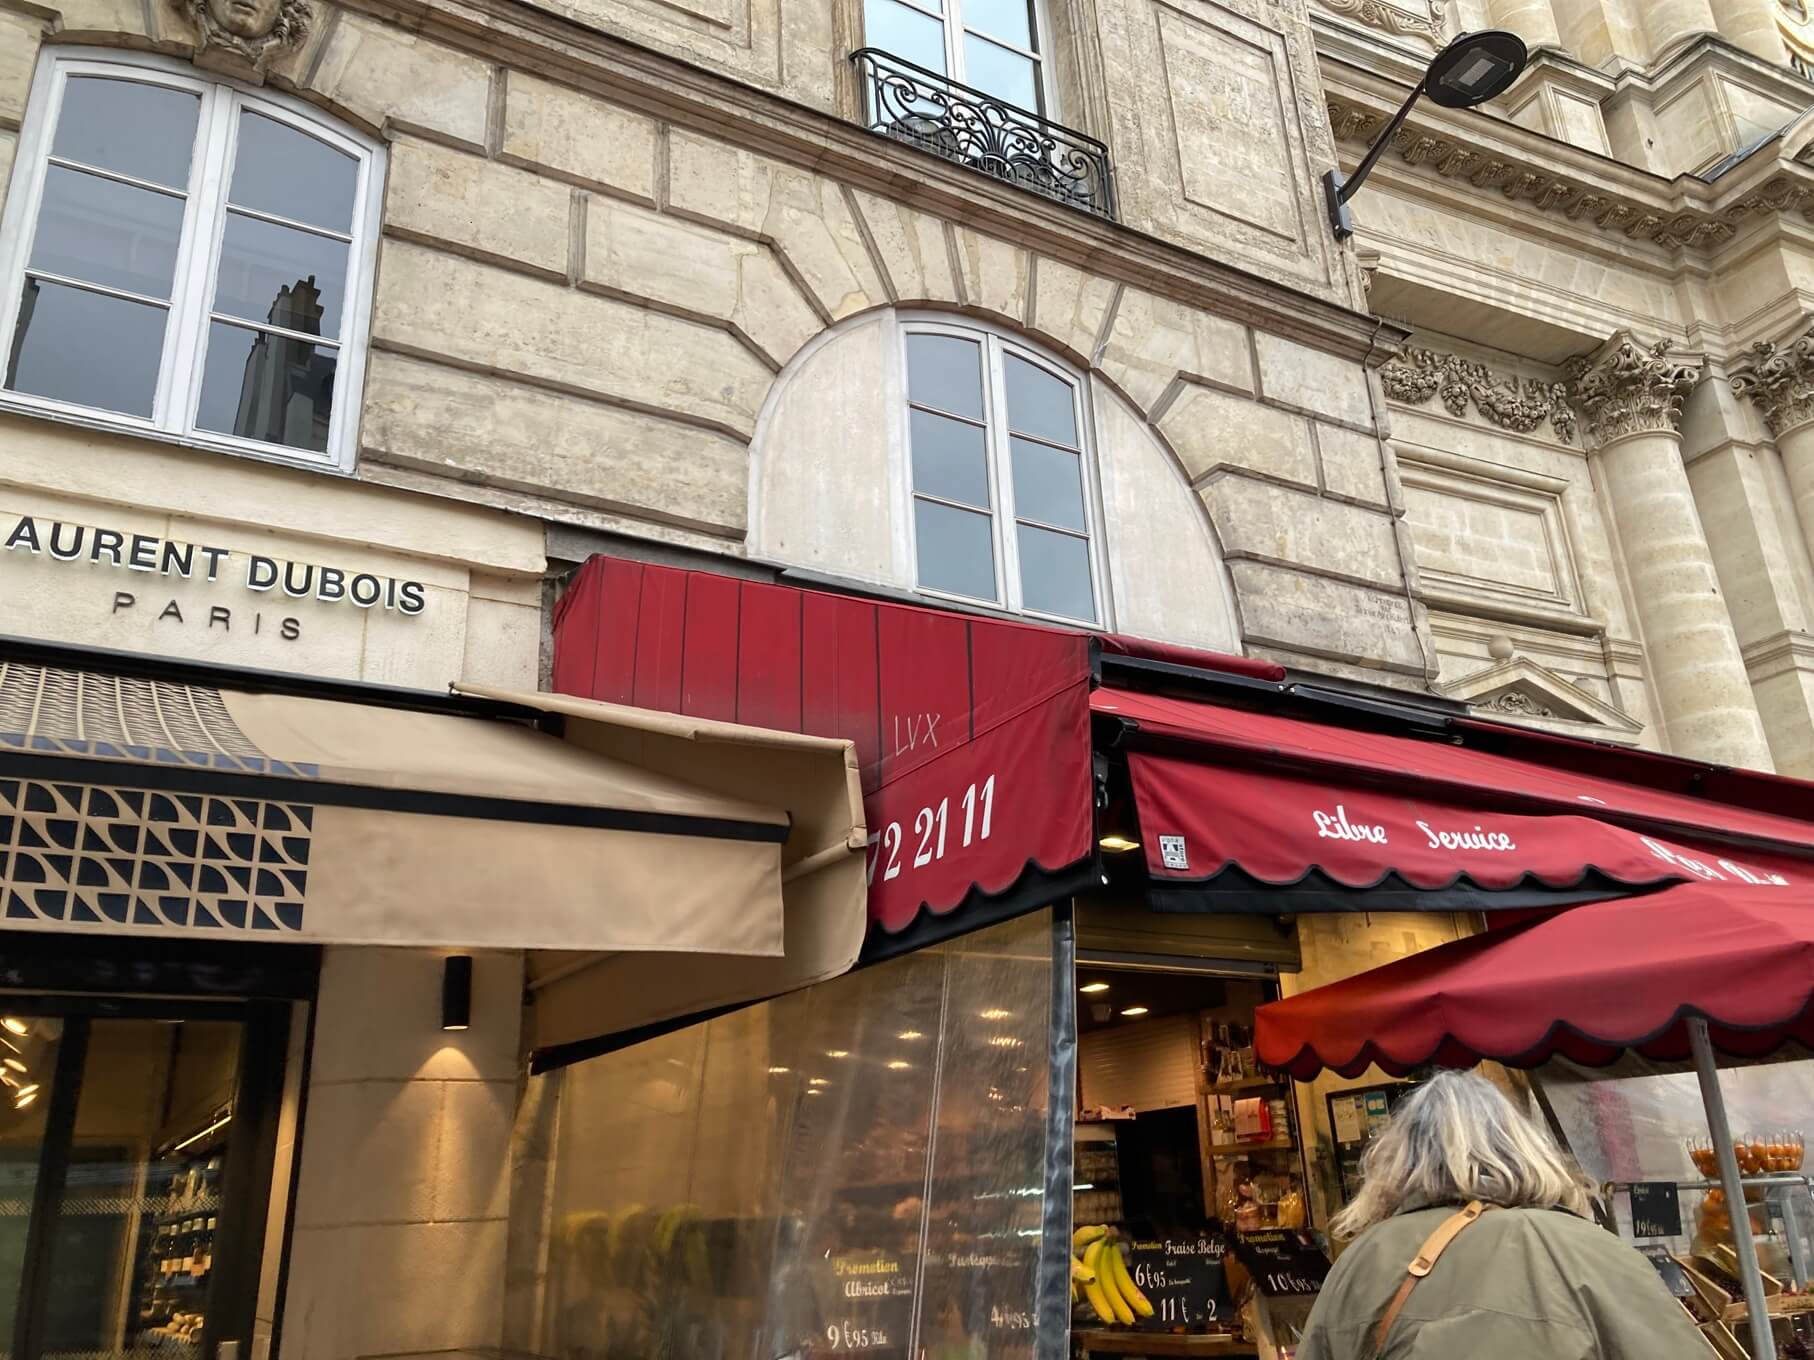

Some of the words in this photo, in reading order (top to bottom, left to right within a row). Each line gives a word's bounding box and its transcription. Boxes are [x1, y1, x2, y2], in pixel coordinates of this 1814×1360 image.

[5, 516, 230, 582] AURENT
[247, 555, 426, 616] DUBOIS
[112, 591, 301, 641] PARIS
[894, 713, 941, 757] LVX
[914, 796, 949, 869] 21
[961, 774, 995, 848] 11
[1312, 804, 1388, 845] Libre
[1415, 820, 1516, 851] Service
[835, 1258, 898, 1276] Promotion
[1165, 1239, 1196, 1255] Fraise
[1197, 1239, 1225, 1258] Belge
[844, 1280, 890, 1298] Abricot
[1206, 1298, 1218, 1322] 2
